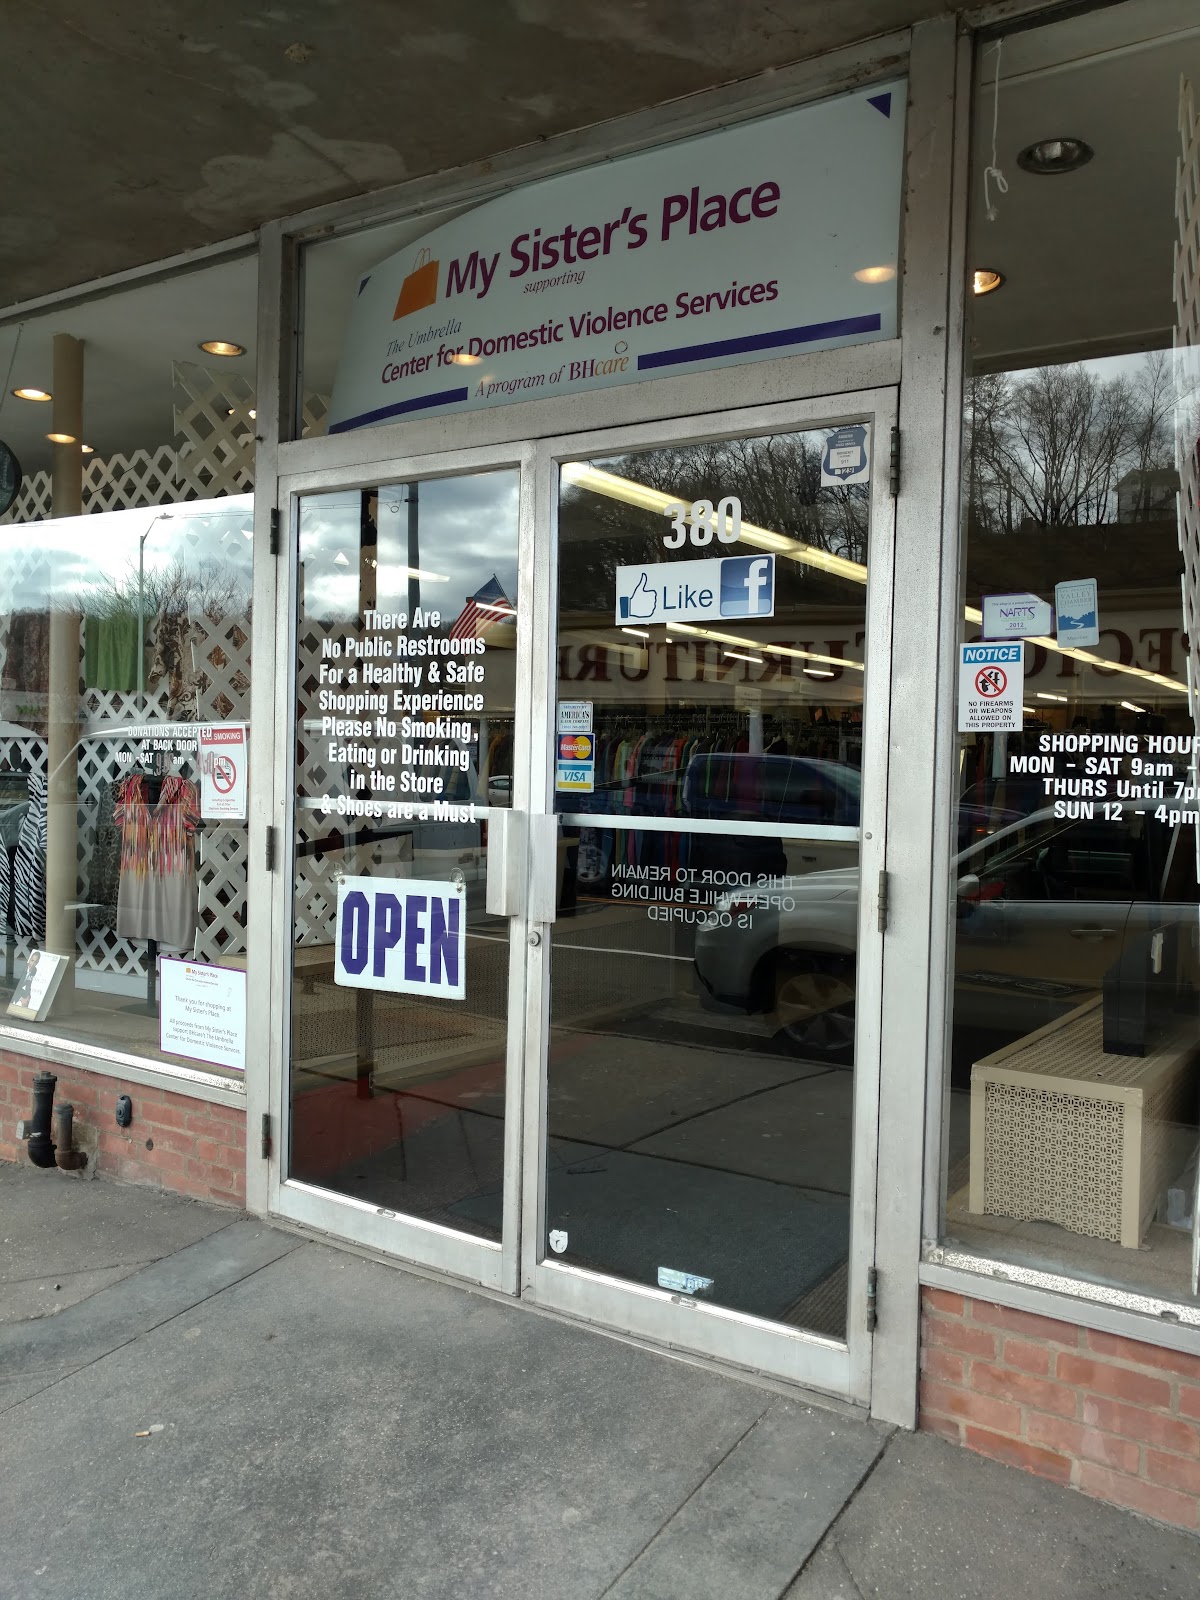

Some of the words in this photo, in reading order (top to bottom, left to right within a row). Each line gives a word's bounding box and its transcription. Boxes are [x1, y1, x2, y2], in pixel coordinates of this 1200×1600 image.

[446, 250, 501, 299] My
[510, 206, 648, 278] Sister's
[661, 181, 781, 242] Place
[523, 269, 585, 294] supporting
[382, 352, 434, 384] Center
[437, 344, 464, 366] for
[468, 320, 564, 358] Domestic
[569, 302, 668, 338] Violence
[676, 280, 779, 318] Services
[386, 340, 405, 357] The
[408, 318, 462, 348] Umbrella
[475, 381, 484, 397] A
[486, 374, 545, 398] program
[550, 365, 566, 383] of
[568, 356, 630, 381] BHcare
[662, 496, 742, 549] 380
[663, 585, 713, 610] Like
[1060, 590, 1091, 599] VALLEY
[1060, 597, 1092, 606] CHAMBER
[364, 609, 407, 630] There
[412, 607, 440, 628] Are
[1000, 606, 1035, 620] NARTS
[322, 638, 340, 658] No
[346, 636, 392, 657] Public
[397, 635, 486, 656] Restrooms
[966, 648, 1018, 661] NOTICE
[319, 664, 344, 684] For
[348, 668, 357, 683] a
[362, 662, 422, 687] Healthy
[428, 662, 440, 684] &
[446, 661, 485, 683] Safe
[318, 690, 388, 714] Shopping
[393, 690, 484, 715] Experience
[561, 711, 590, 719] AMERICA'S
[128, 726, 169, 737] DONATIONS
[173, 727, 212, 738] ACCEPTED
[214, 732, 240, 740] SMOKING
[322, 716, 372, 737] Please
[377, 716, 396, 737] No
[142, 739, 150, 750] AT
[153, 740, 173, 750] BACK
[176, 740, 198, 751] DOOR
[1039, 735, 1139, 753] SHOPPING
[116, 752, 132, 763] MON
[328, 743, 376, 768] Eating
[380, 747, 397, 765] or
[401, 744, 470, 771] Drinking
[1010, 756, 1055, 773] MON
[1085, 757, 1122, 775] SAT
[1131, 758, 1174, 776] 9am
[350, 770, 366, 790] in
[370, 771, 396, 791] the
[400, 771, 444, 794] Store
[564, 772, 586, 782] VISA
[1042, 778, 1107, 797] THURS
[1116, 780, 1164, 799] Until
[320, 794, 332, 814] &
[336, 794, 383, 818] Shoes
[388, 803, 413, 819] are
[419, 804, 429, 821] a
[433, 800, 476, 824] Must
[1054, 800, 1094, 820] SUN
[1103, 803, 1122, 821] 12
[1154, 805, 1200, 827] 4pm
[340, 890, 460, 987] OPEN
[193, 1007, 207, 1015] Sister's
[205, 1002, 225, 1012] shopping
[212, 1027, 226, 1035] Sister's
[227, 1030, 238, 1038] Place
[215, 1036, 234, 1044] Umbrella
[187, 1037, 205, 1046] Domestic
[206, 1042, 223, 1050] Violence
